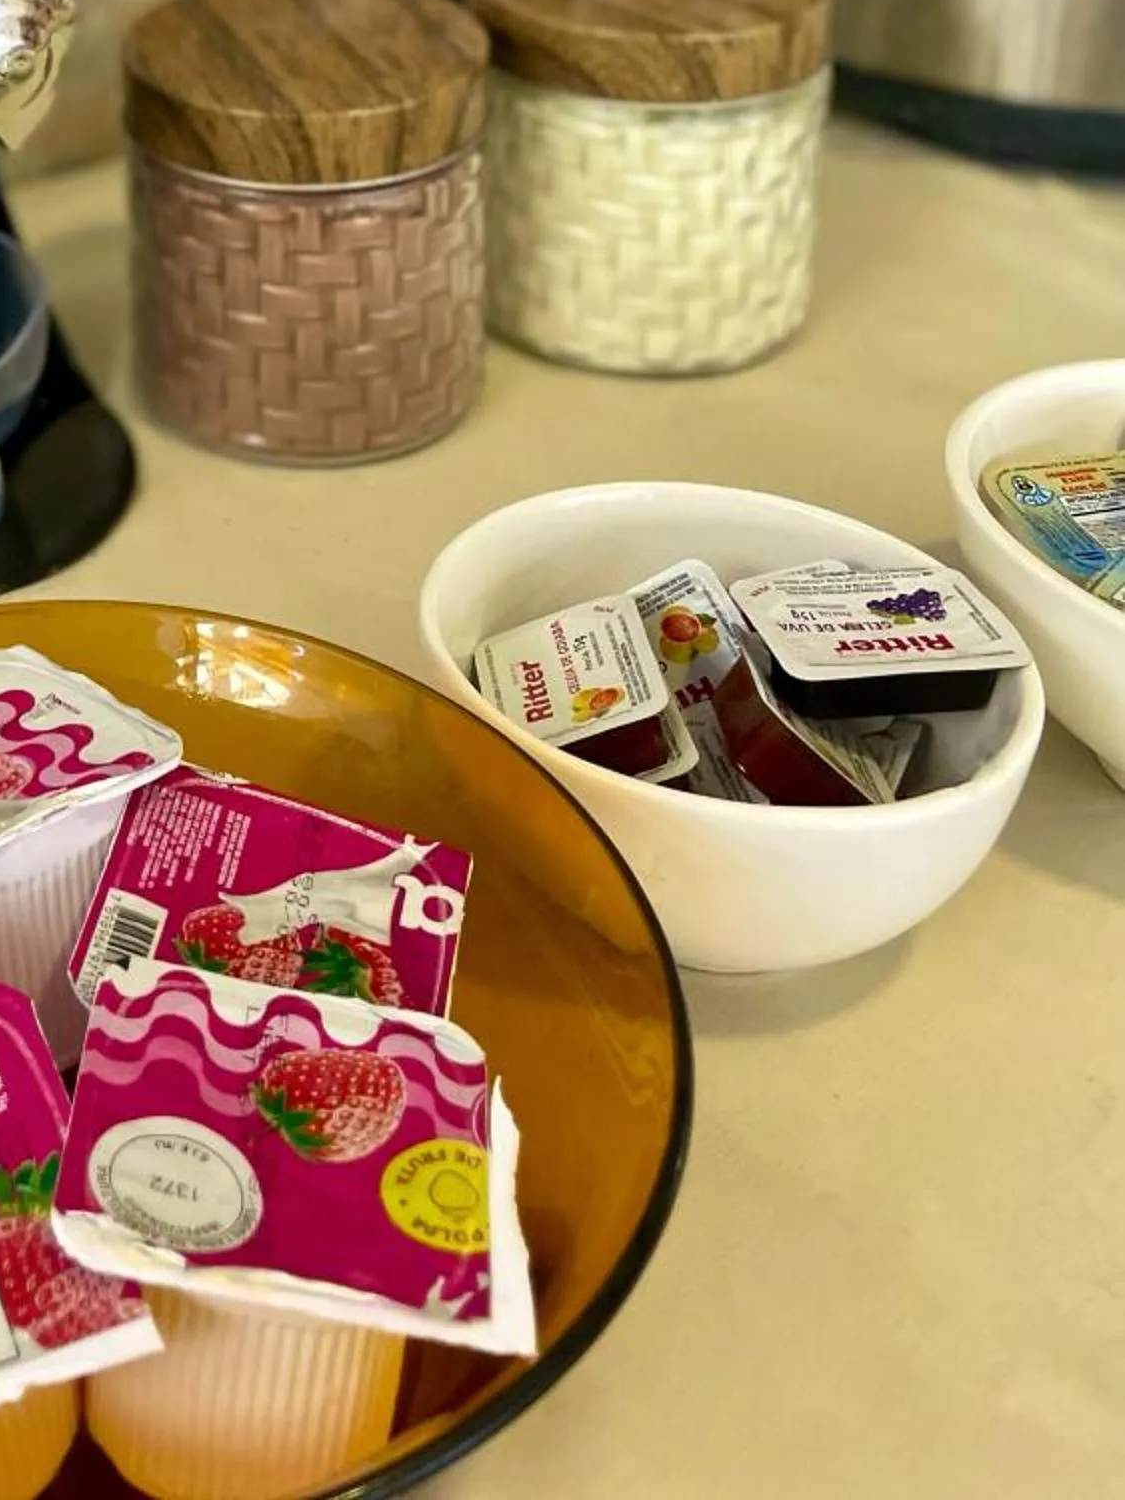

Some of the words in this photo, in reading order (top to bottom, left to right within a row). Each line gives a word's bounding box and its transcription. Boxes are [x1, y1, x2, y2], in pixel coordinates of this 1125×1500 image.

[778, 621, 812, 633] UVA
[814, 621, 836, 633] DE
[834, 634, 956, 653] Ritter
[520, 660, 554, 724] Ritter
[149, 1174, 199, 1203] 1372
